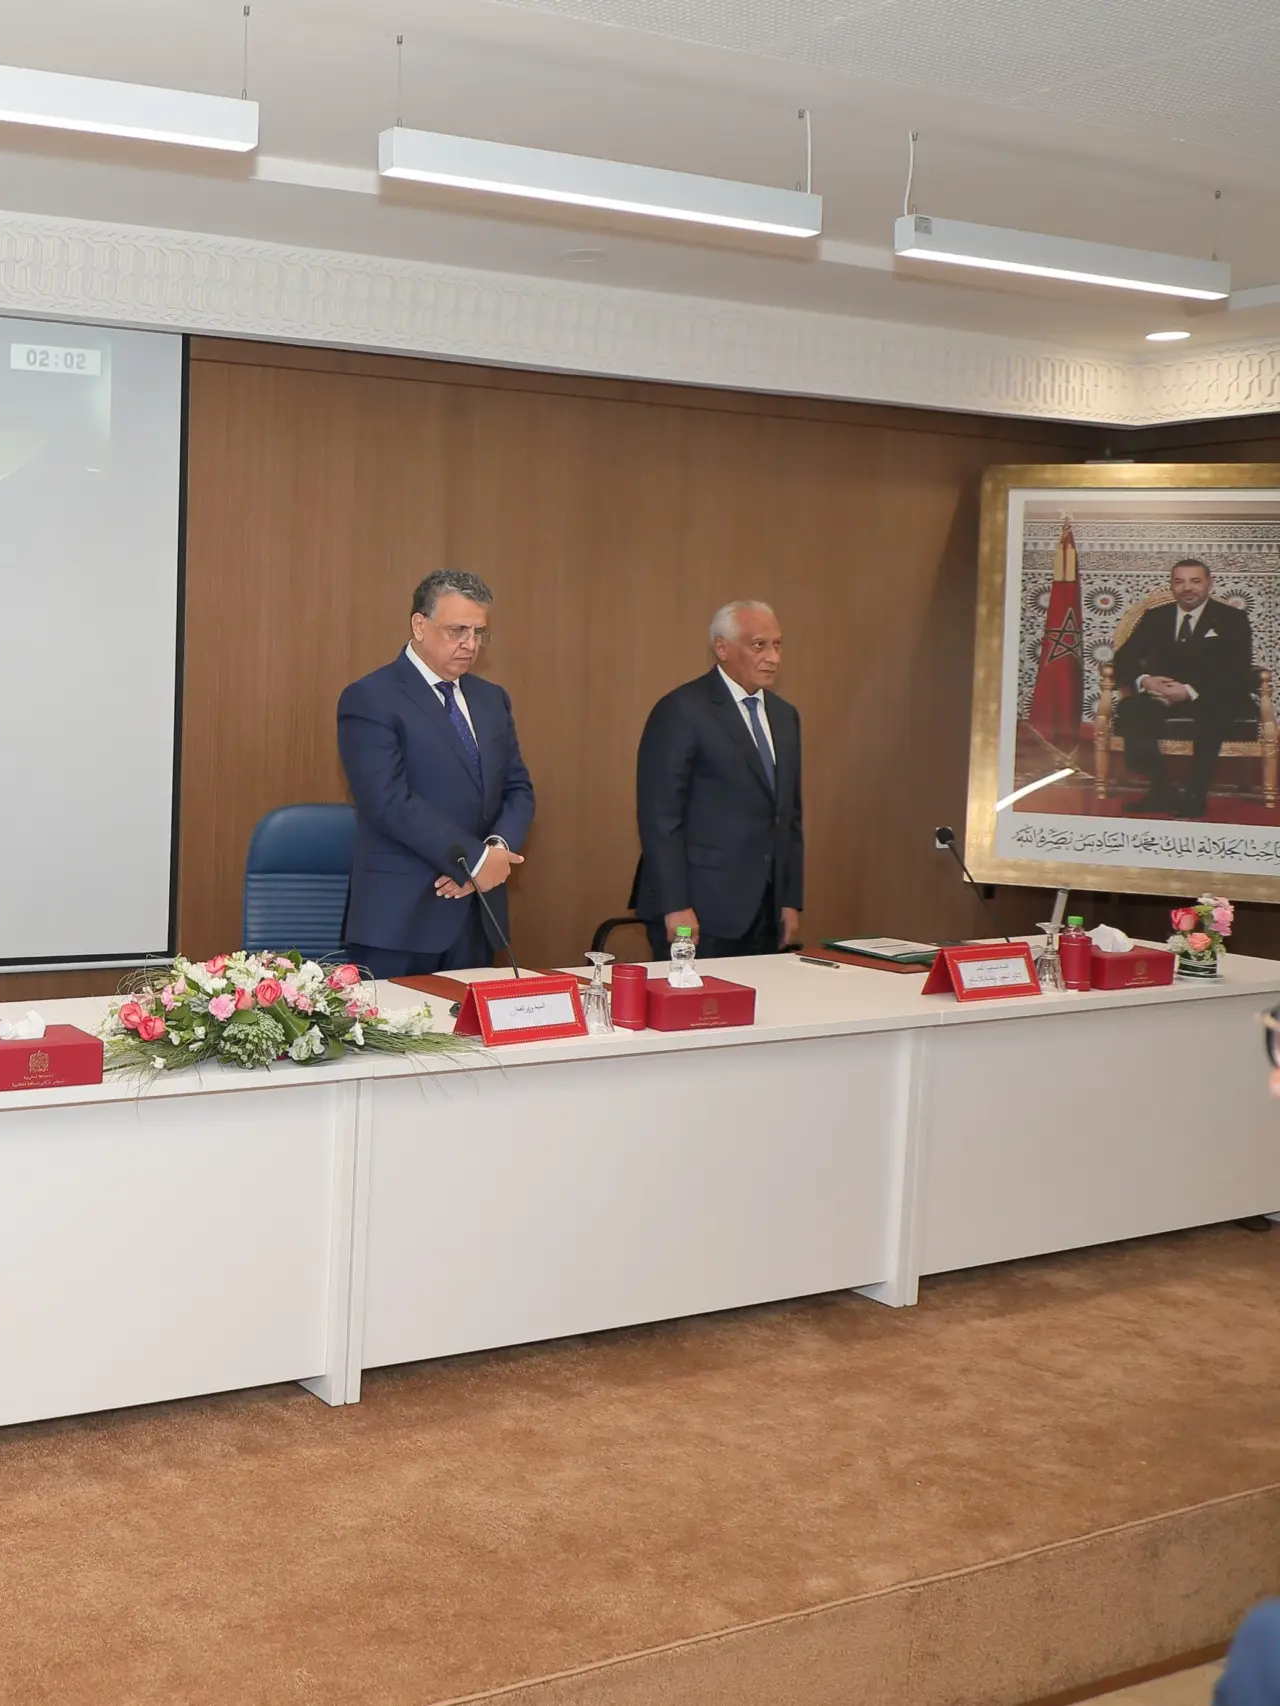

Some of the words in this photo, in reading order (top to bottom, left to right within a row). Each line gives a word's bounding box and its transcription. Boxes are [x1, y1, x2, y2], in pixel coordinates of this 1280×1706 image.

[26, 348, 86, 370] 02:02
[1011, 823, 1036, 848] الله
[1073, 831, 1130, 854] السادس
[1130, 830, 1160, 855] محمد
[1160, 835, 1196, 858] الملك
